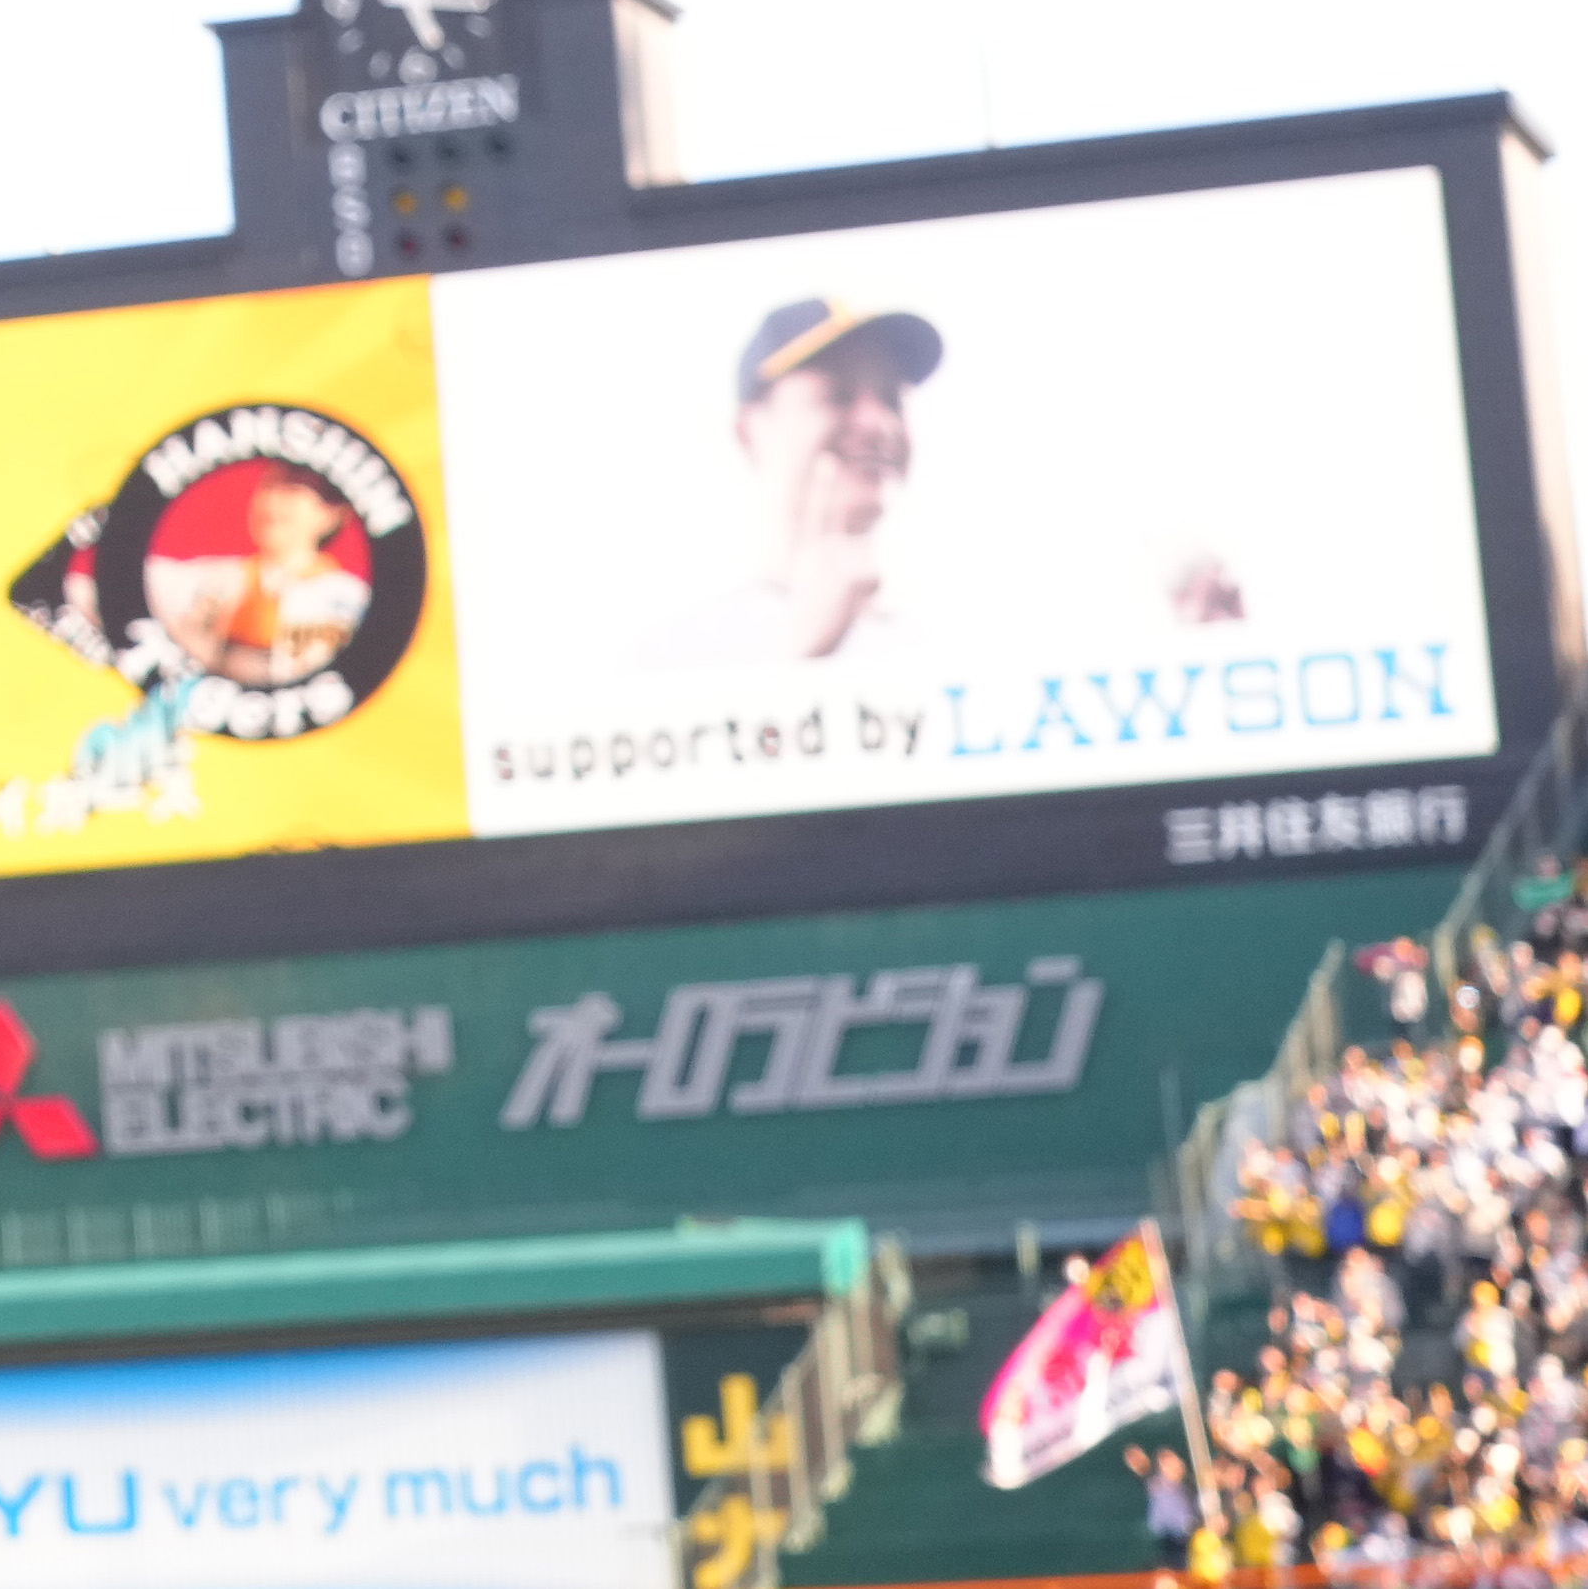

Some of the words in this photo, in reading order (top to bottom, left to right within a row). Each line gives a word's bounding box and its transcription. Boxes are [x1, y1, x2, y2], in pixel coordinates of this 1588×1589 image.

[488, 705, 827, 785] supported
[856, 701, 928, 759] by
[944, 642, 1455, 758] LAWSON
[95, 1005, 453, 1091] MITSUBISHI
[105, 1075, 415, 1157] ELECTRIC
[164, 1467, 362, 1540] very
[386, 1444, 625, 1519] much
